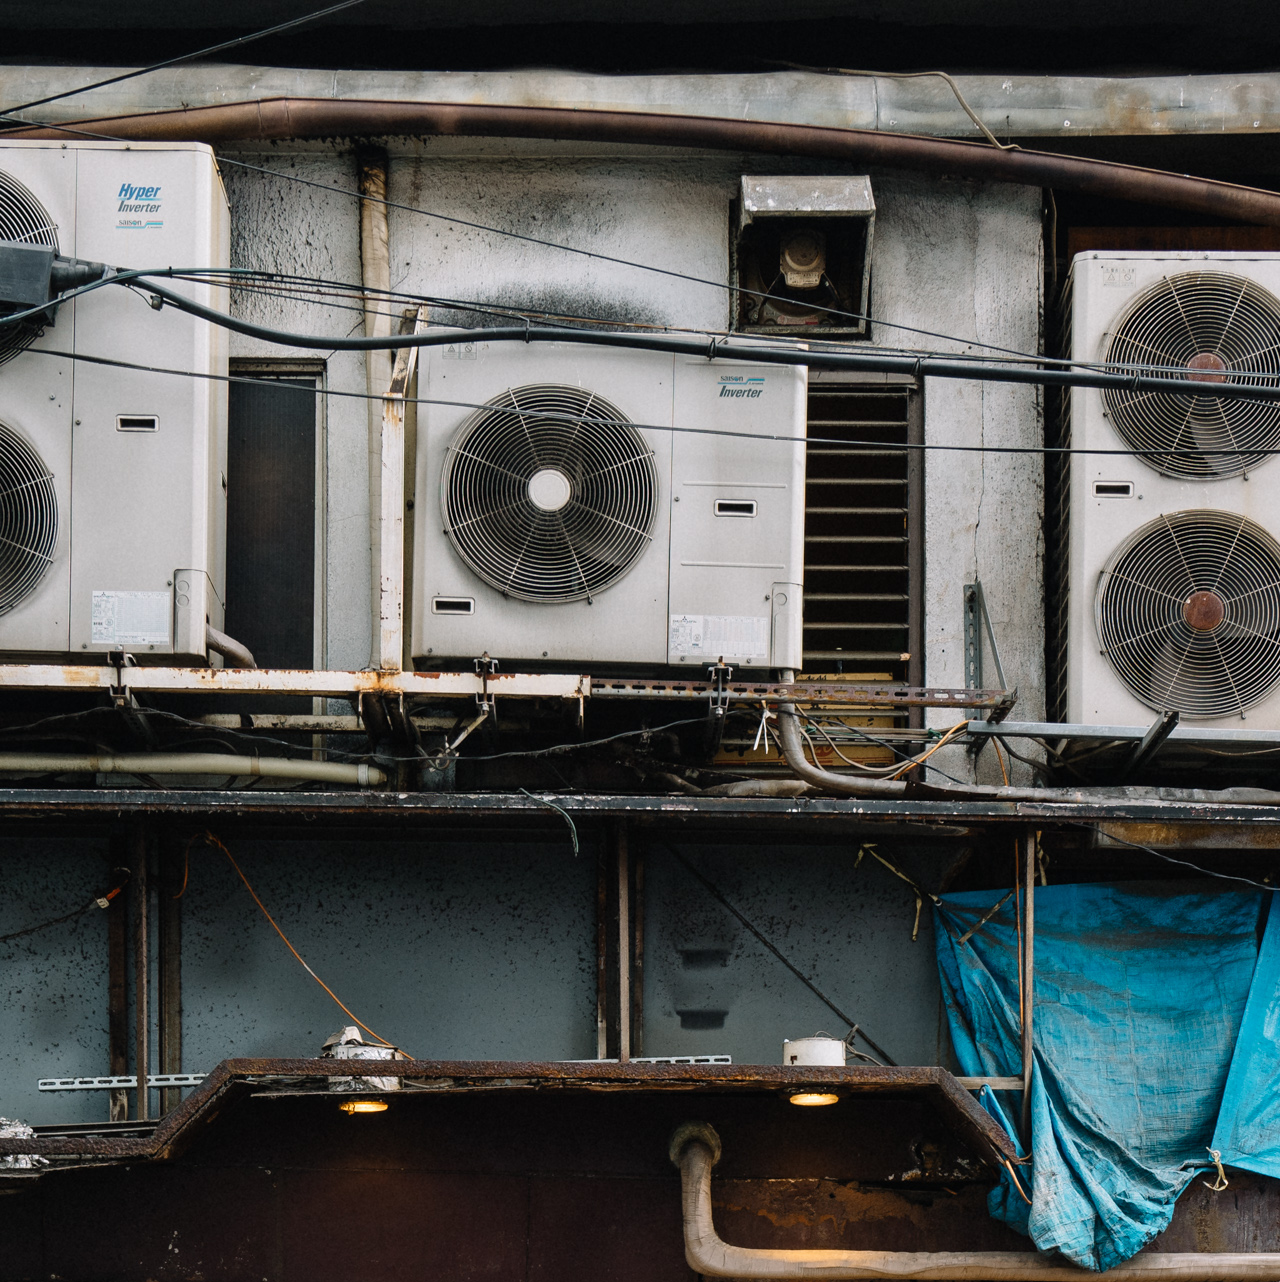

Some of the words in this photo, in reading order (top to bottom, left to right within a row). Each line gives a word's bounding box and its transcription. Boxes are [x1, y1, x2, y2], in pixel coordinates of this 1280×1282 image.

[118, 183, 161, 200] Hyper
[117, 200, 161, 212] Inverter
[719, 385, 763, 398] Inverter
